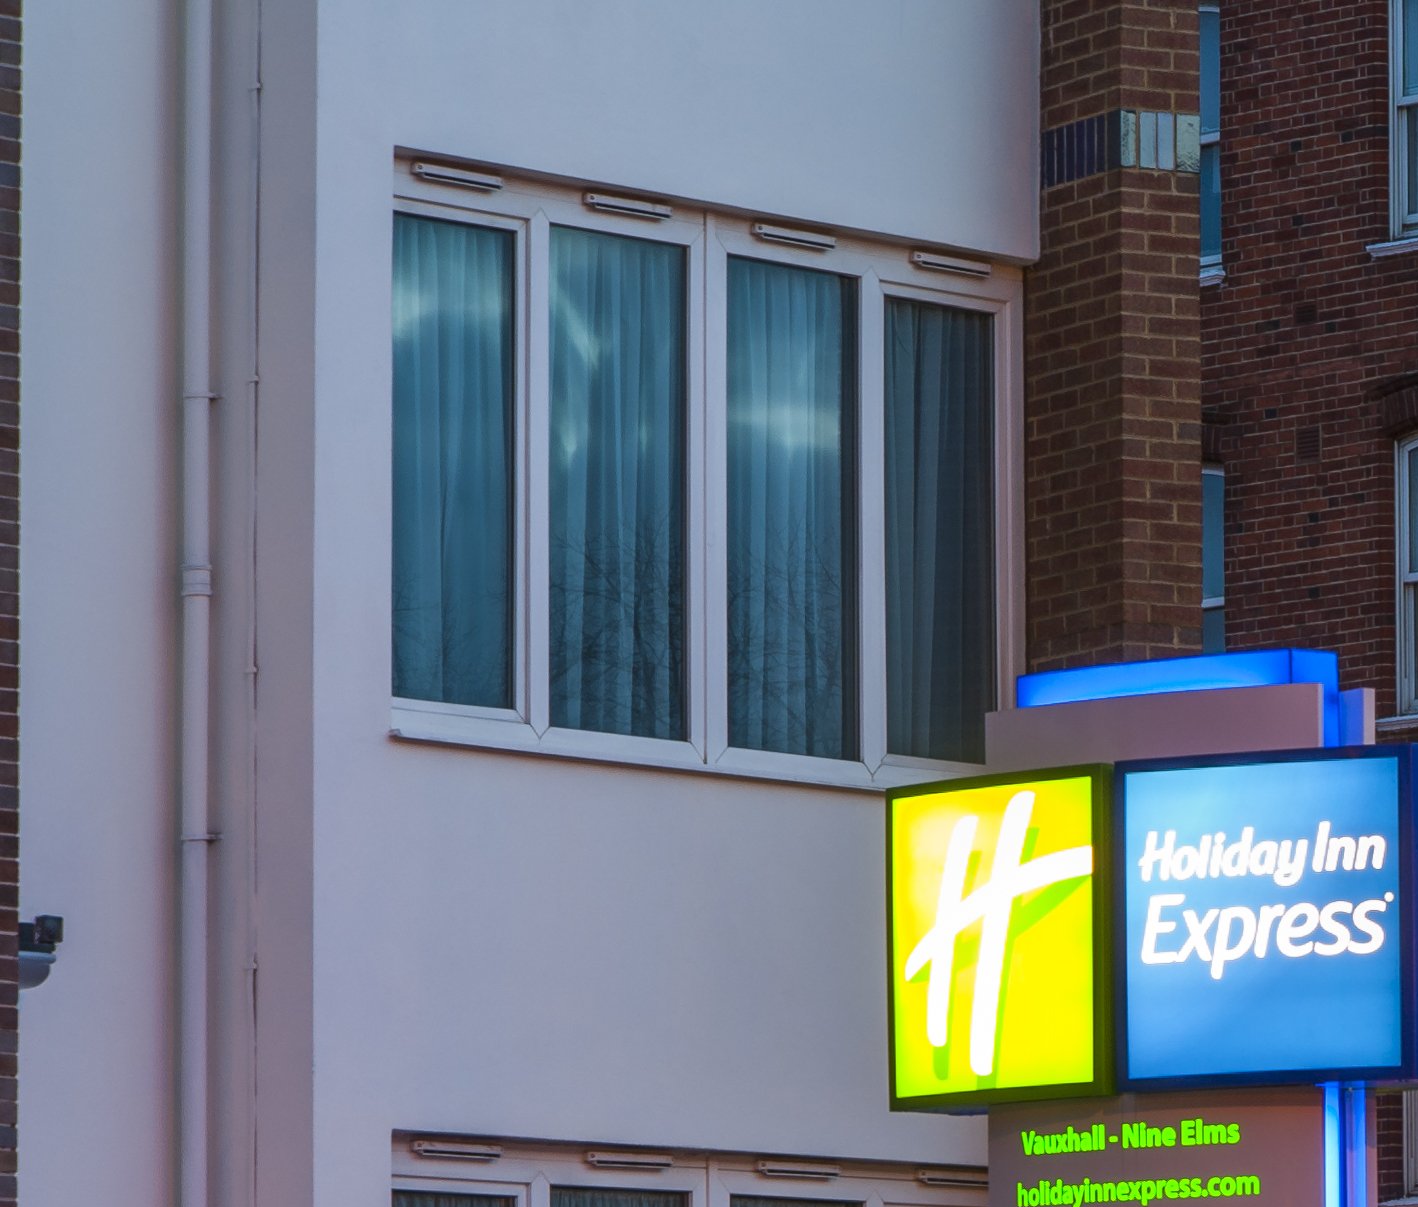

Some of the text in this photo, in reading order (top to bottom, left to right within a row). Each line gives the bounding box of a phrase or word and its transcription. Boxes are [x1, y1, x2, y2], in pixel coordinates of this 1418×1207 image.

[1138, 820, 1386, 887] Holiday Inn
[1140, 892, 1388, 979] Express
[1021, 1123, 1106, 1156] Vauxhall
[1122, 1121, 1176, 1149] Nine
[1180, 1118, 1240, 1146] Elms
